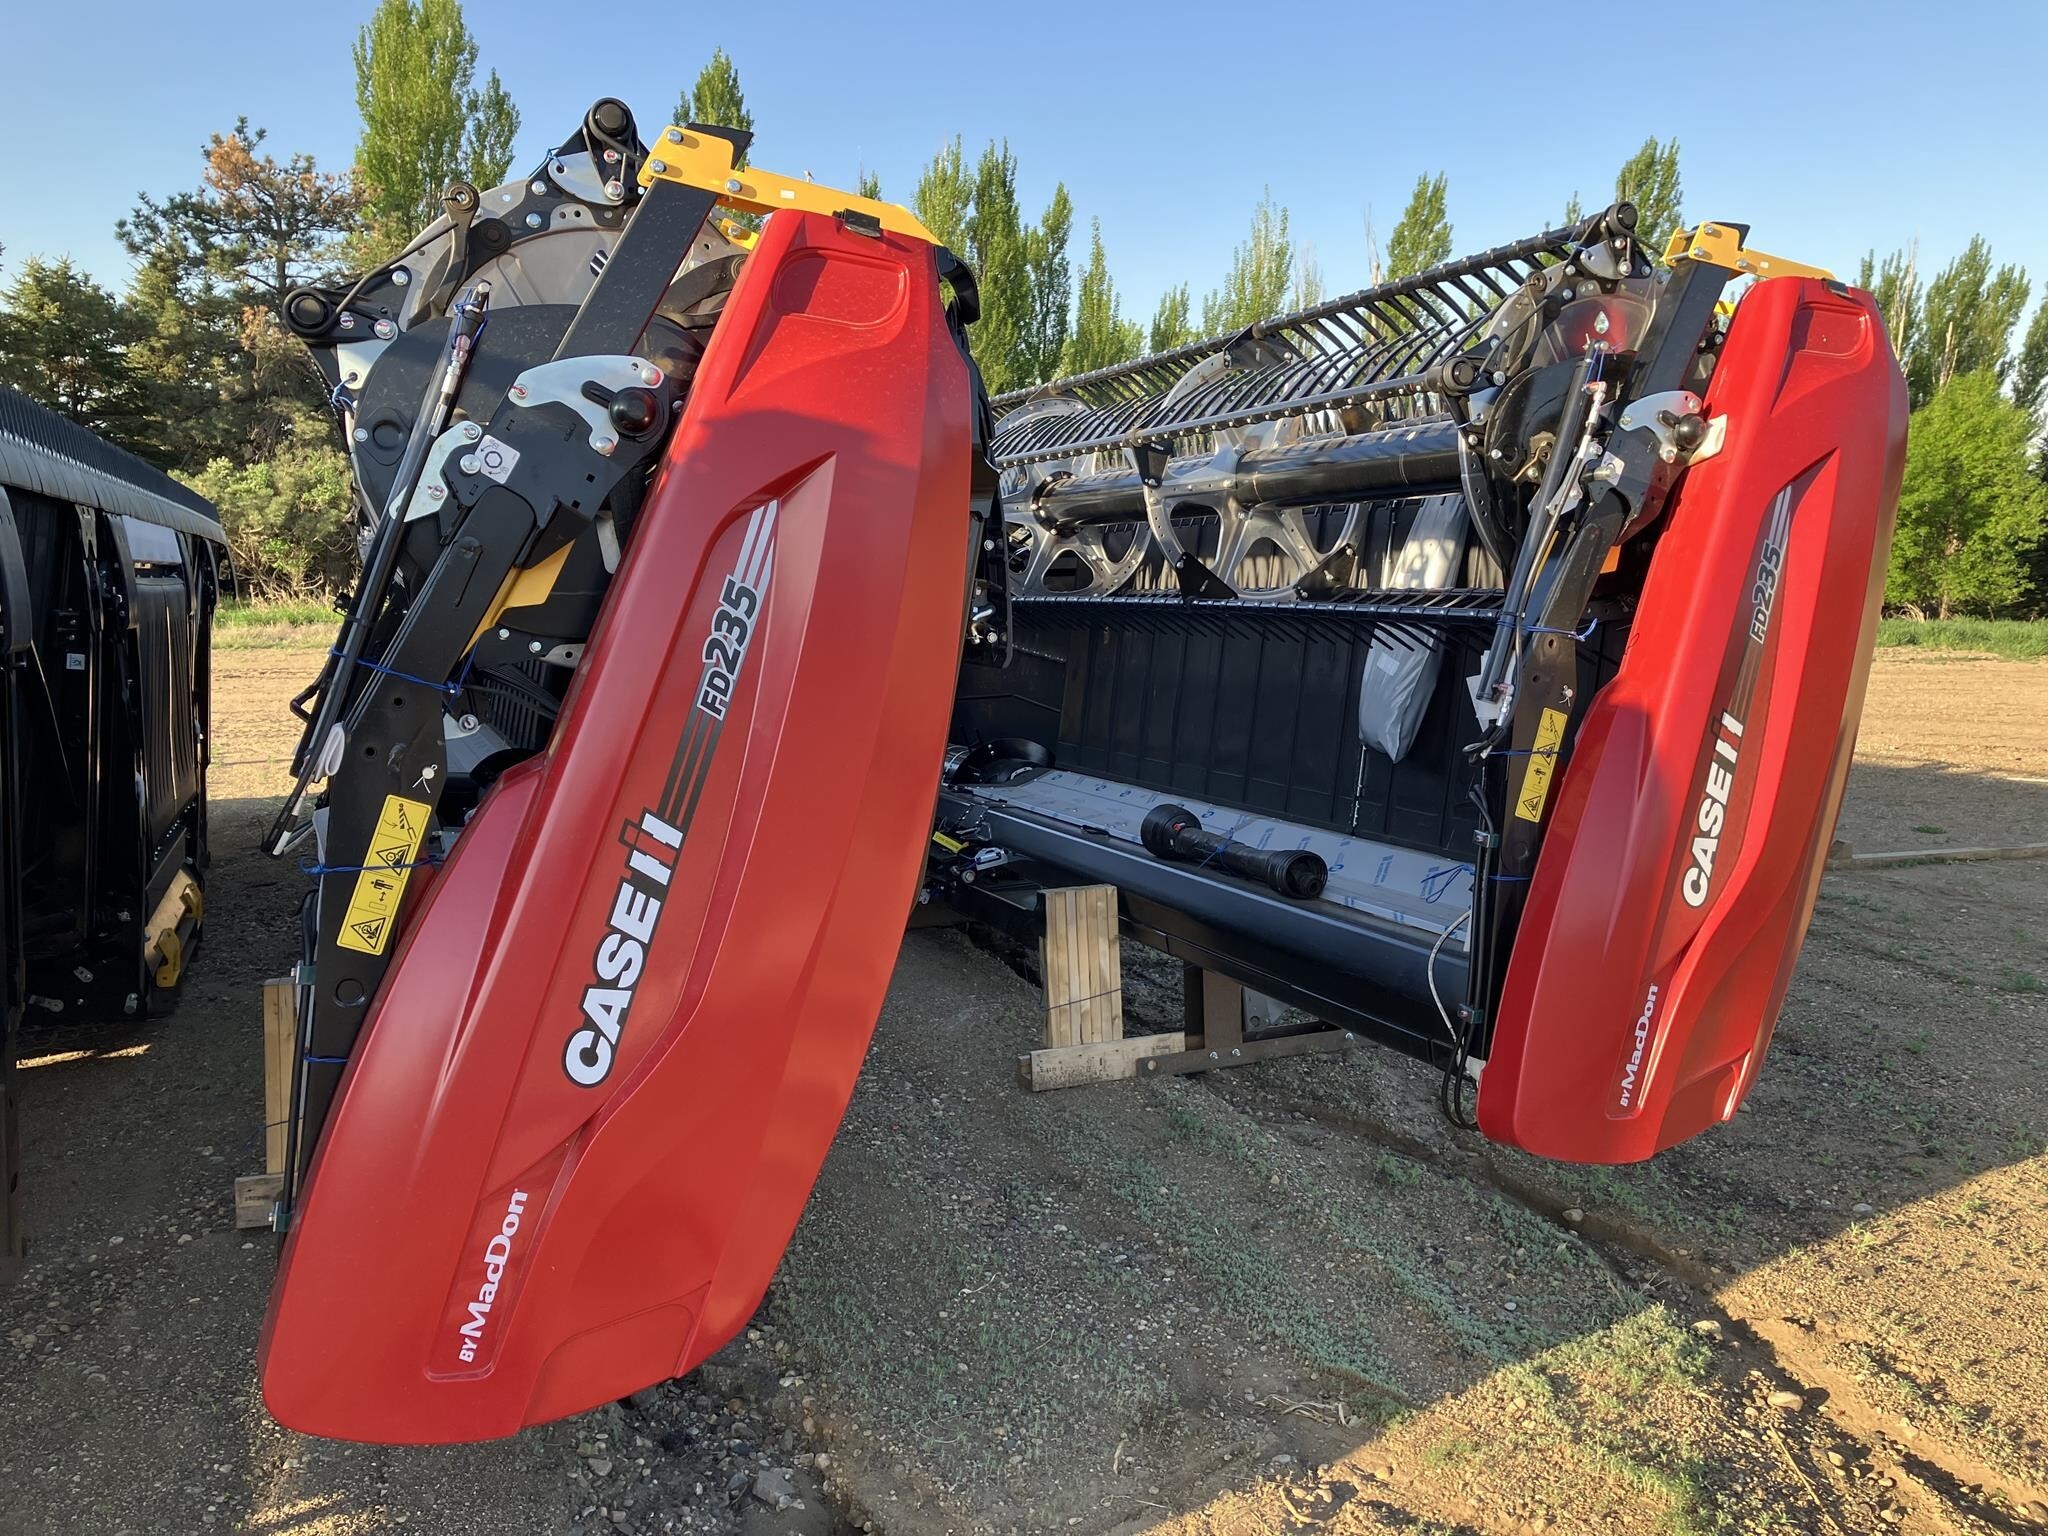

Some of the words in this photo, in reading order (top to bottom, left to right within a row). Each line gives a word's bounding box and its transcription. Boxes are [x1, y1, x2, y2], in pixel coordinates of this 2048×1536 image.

[698, 574, 760, 721] FD235
[1749, 540, 1782, 645] FD235
[1683, 761, 1733, 907] CASE
[565, 881, 661, 1086] CASE
[1621, 984, 1659, 1090] MacDon
[1620, 1089, 1631, 1107] BY
[459, 1191, 529, 1338] MacDon
[458, 1337, 478, 1363] BY
